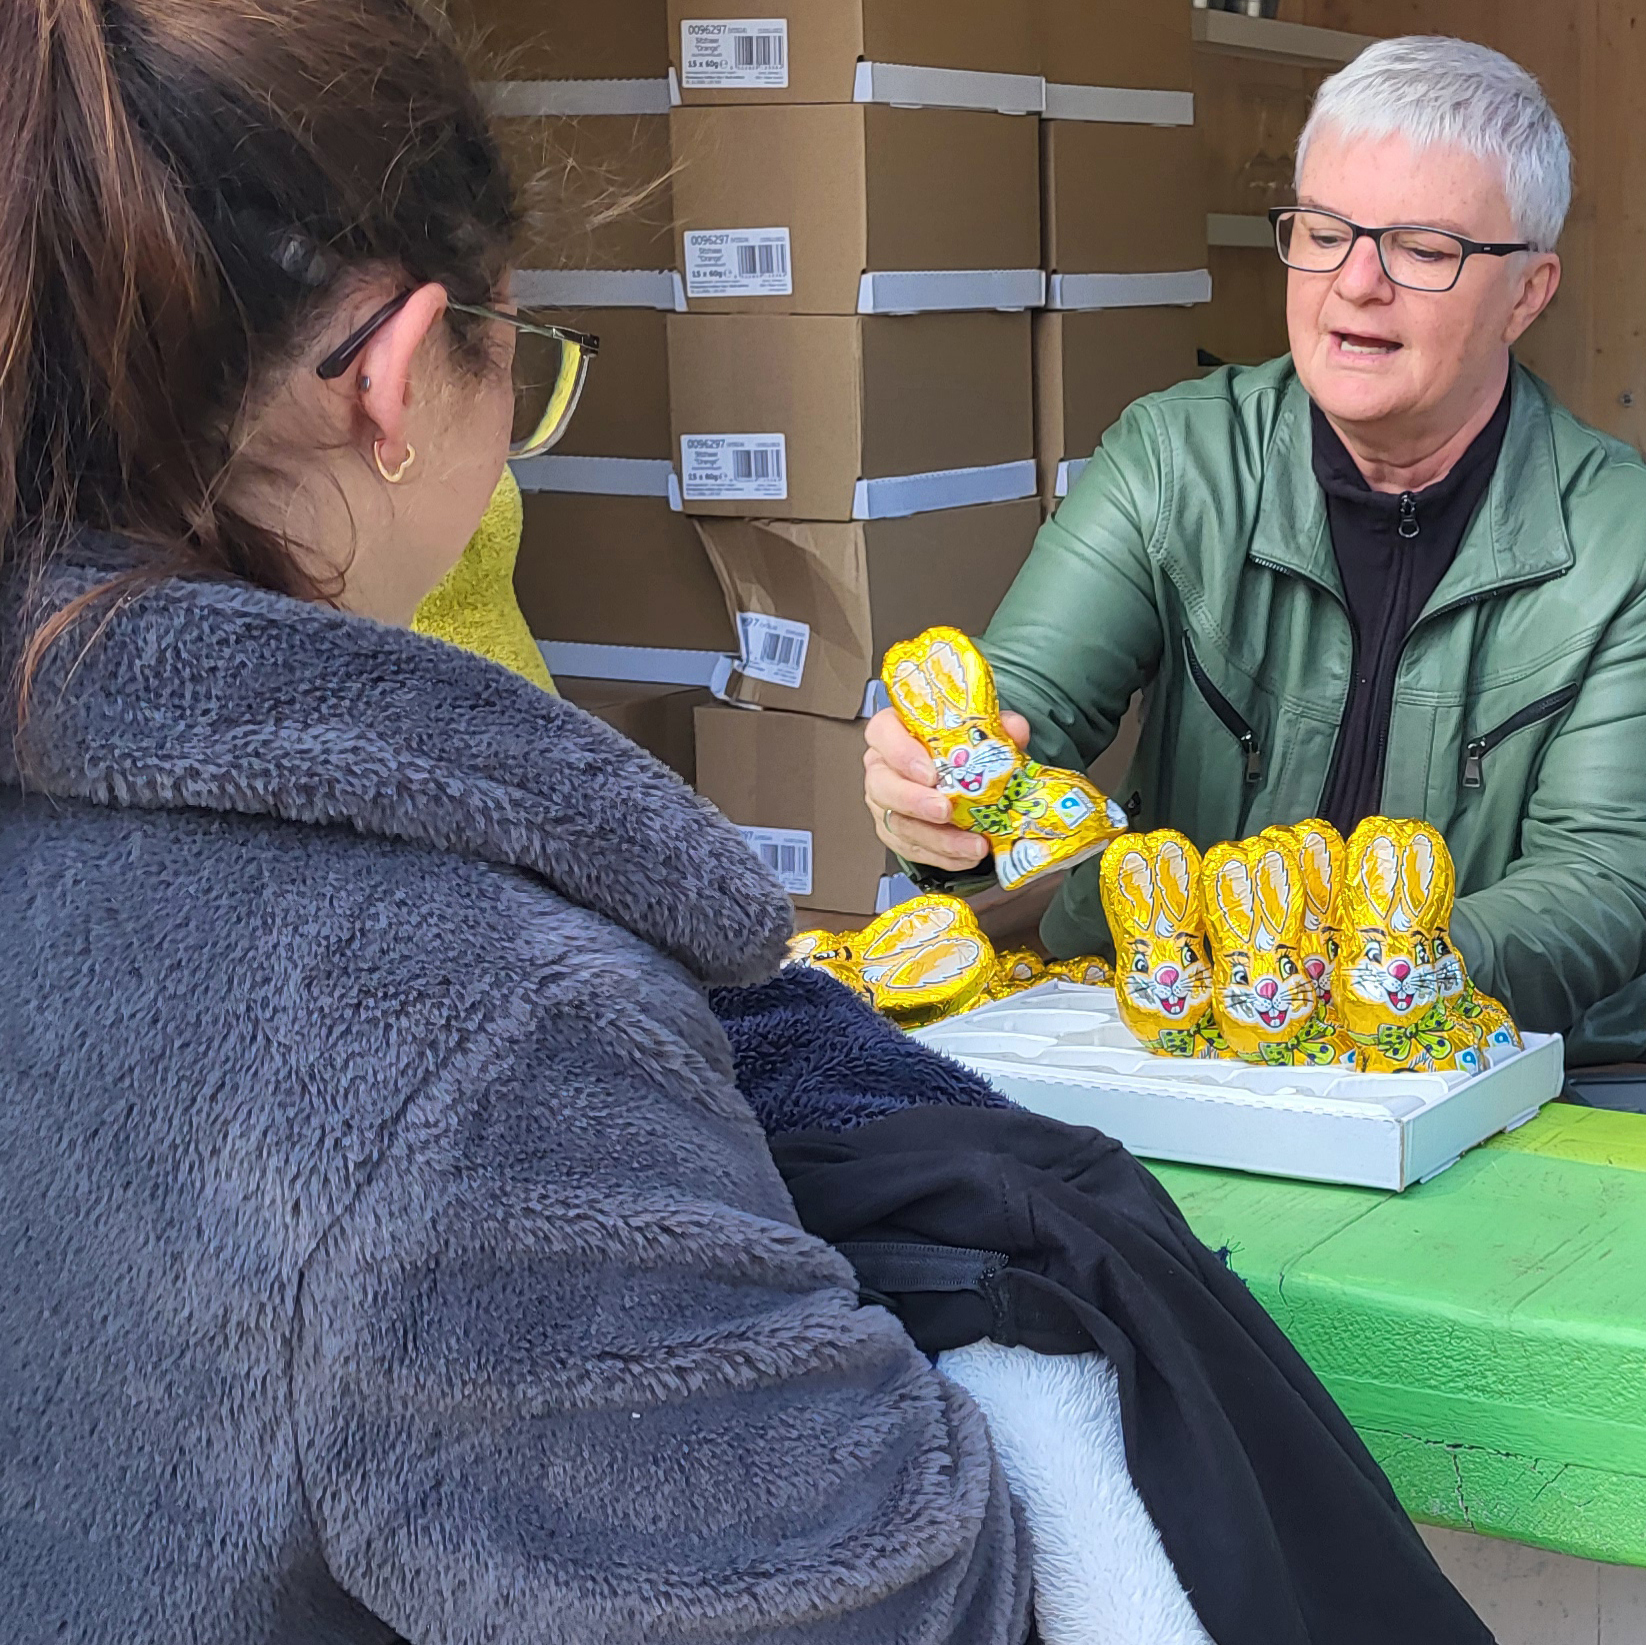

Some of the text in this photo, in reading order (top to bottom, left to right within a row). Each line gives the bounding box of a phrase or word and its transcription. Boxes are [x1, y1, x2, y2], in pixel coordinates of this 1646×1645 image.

[688, 25, 727, 35] 0096297
[688, 60, 697, 68] 15
[691, 235, 729, 246] 0096297
